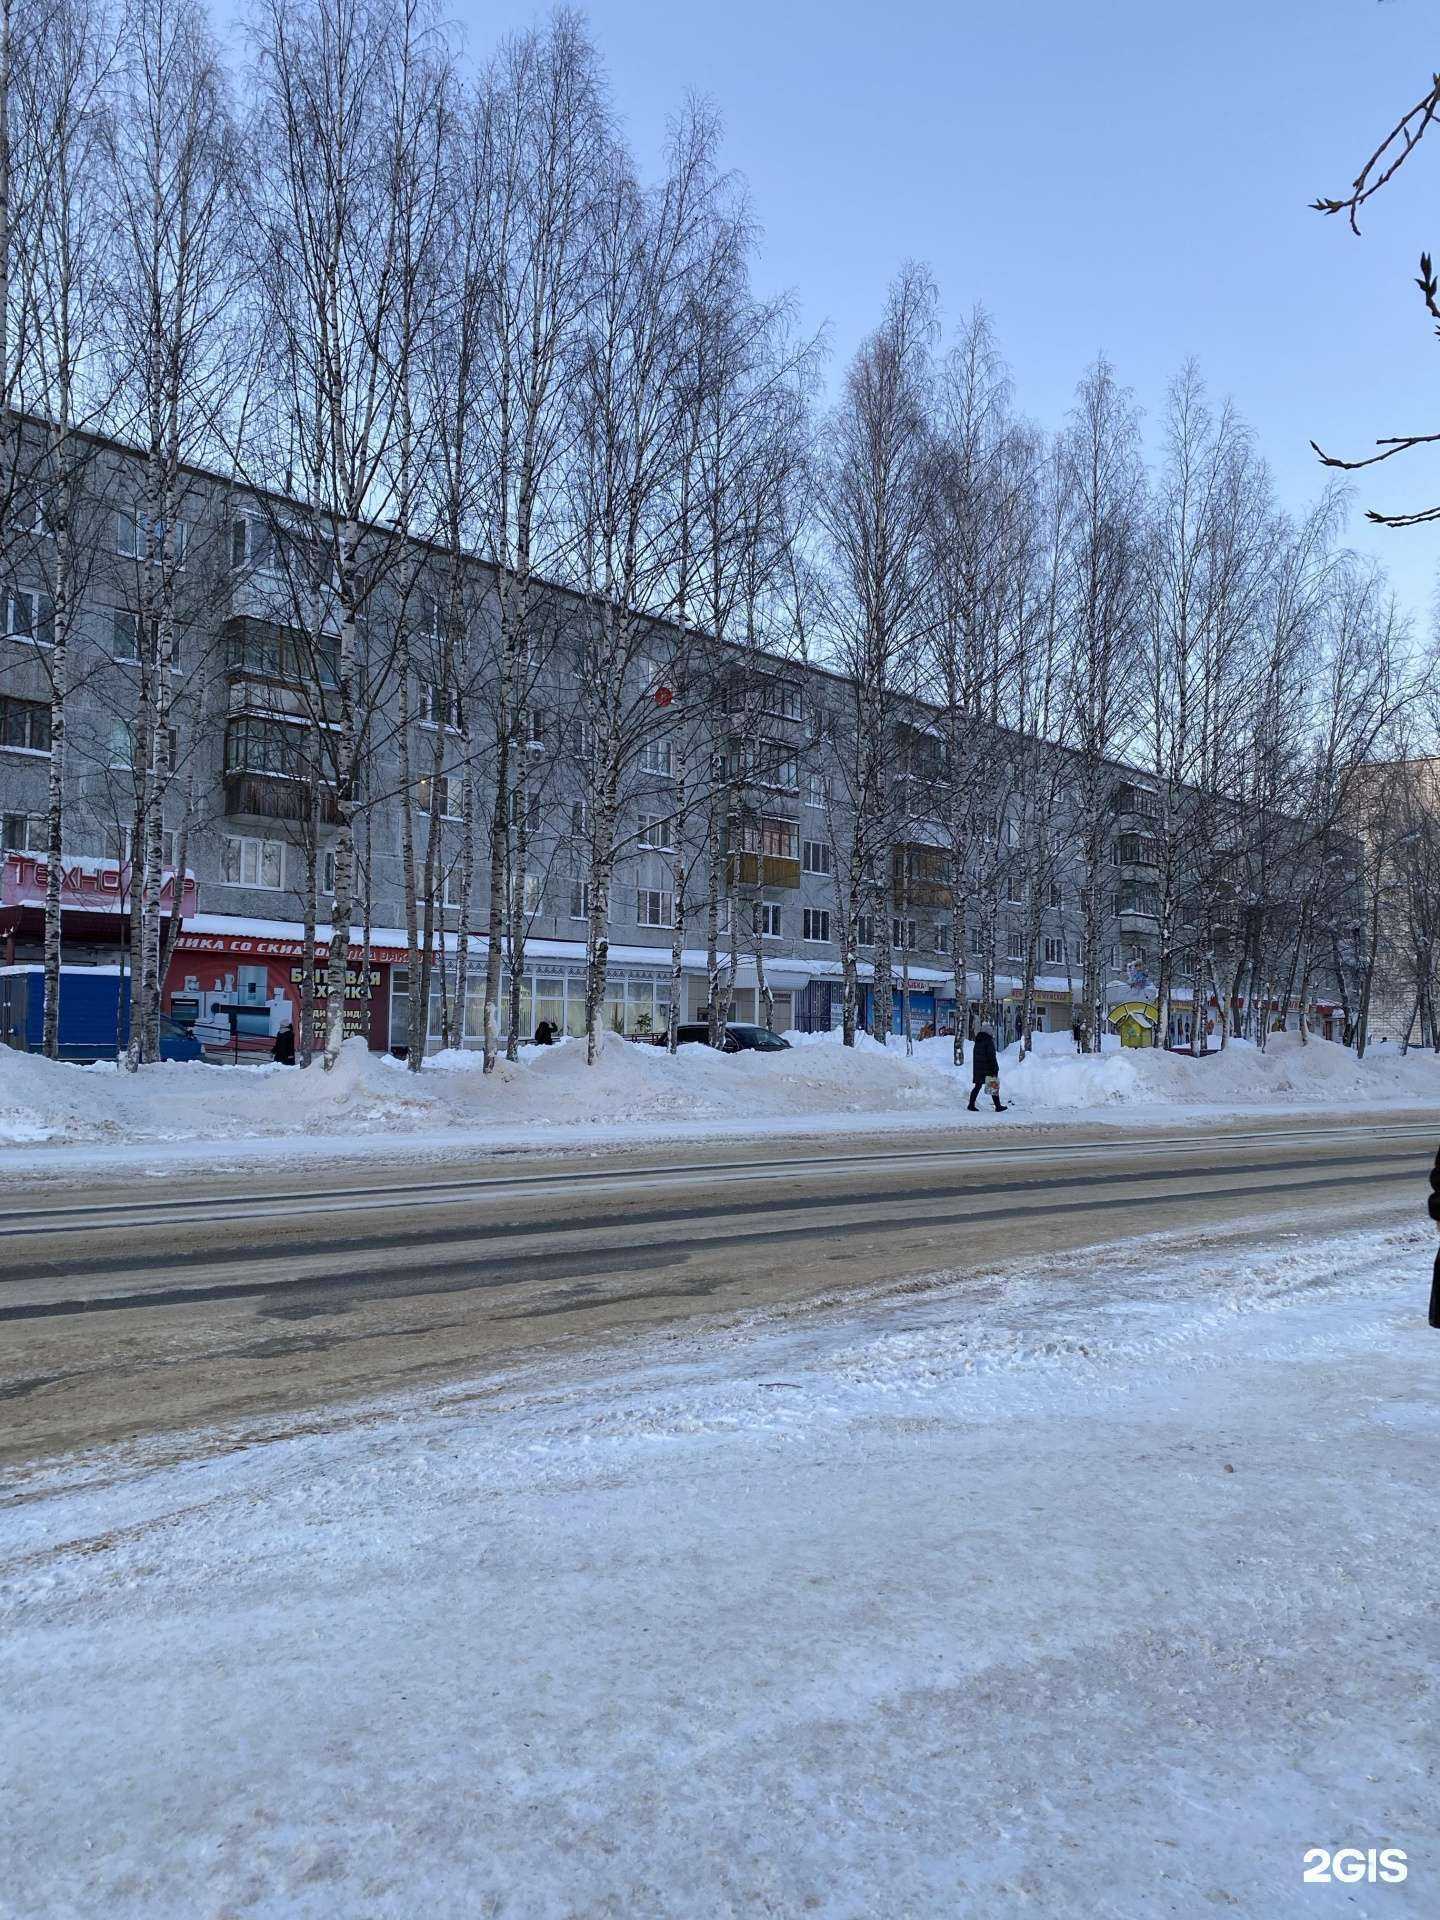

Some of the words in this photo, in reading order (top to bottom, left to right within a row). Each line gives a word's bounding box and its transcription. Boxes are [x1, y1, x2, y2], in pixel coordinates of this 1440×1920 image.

[6, 856, 196, 898] ТЕХНОИР
[230, 941, 252, 951] СО
[256, 943, 330, 957] СКИДО
[290, 967, 381, 986] БЫТВАЯ
